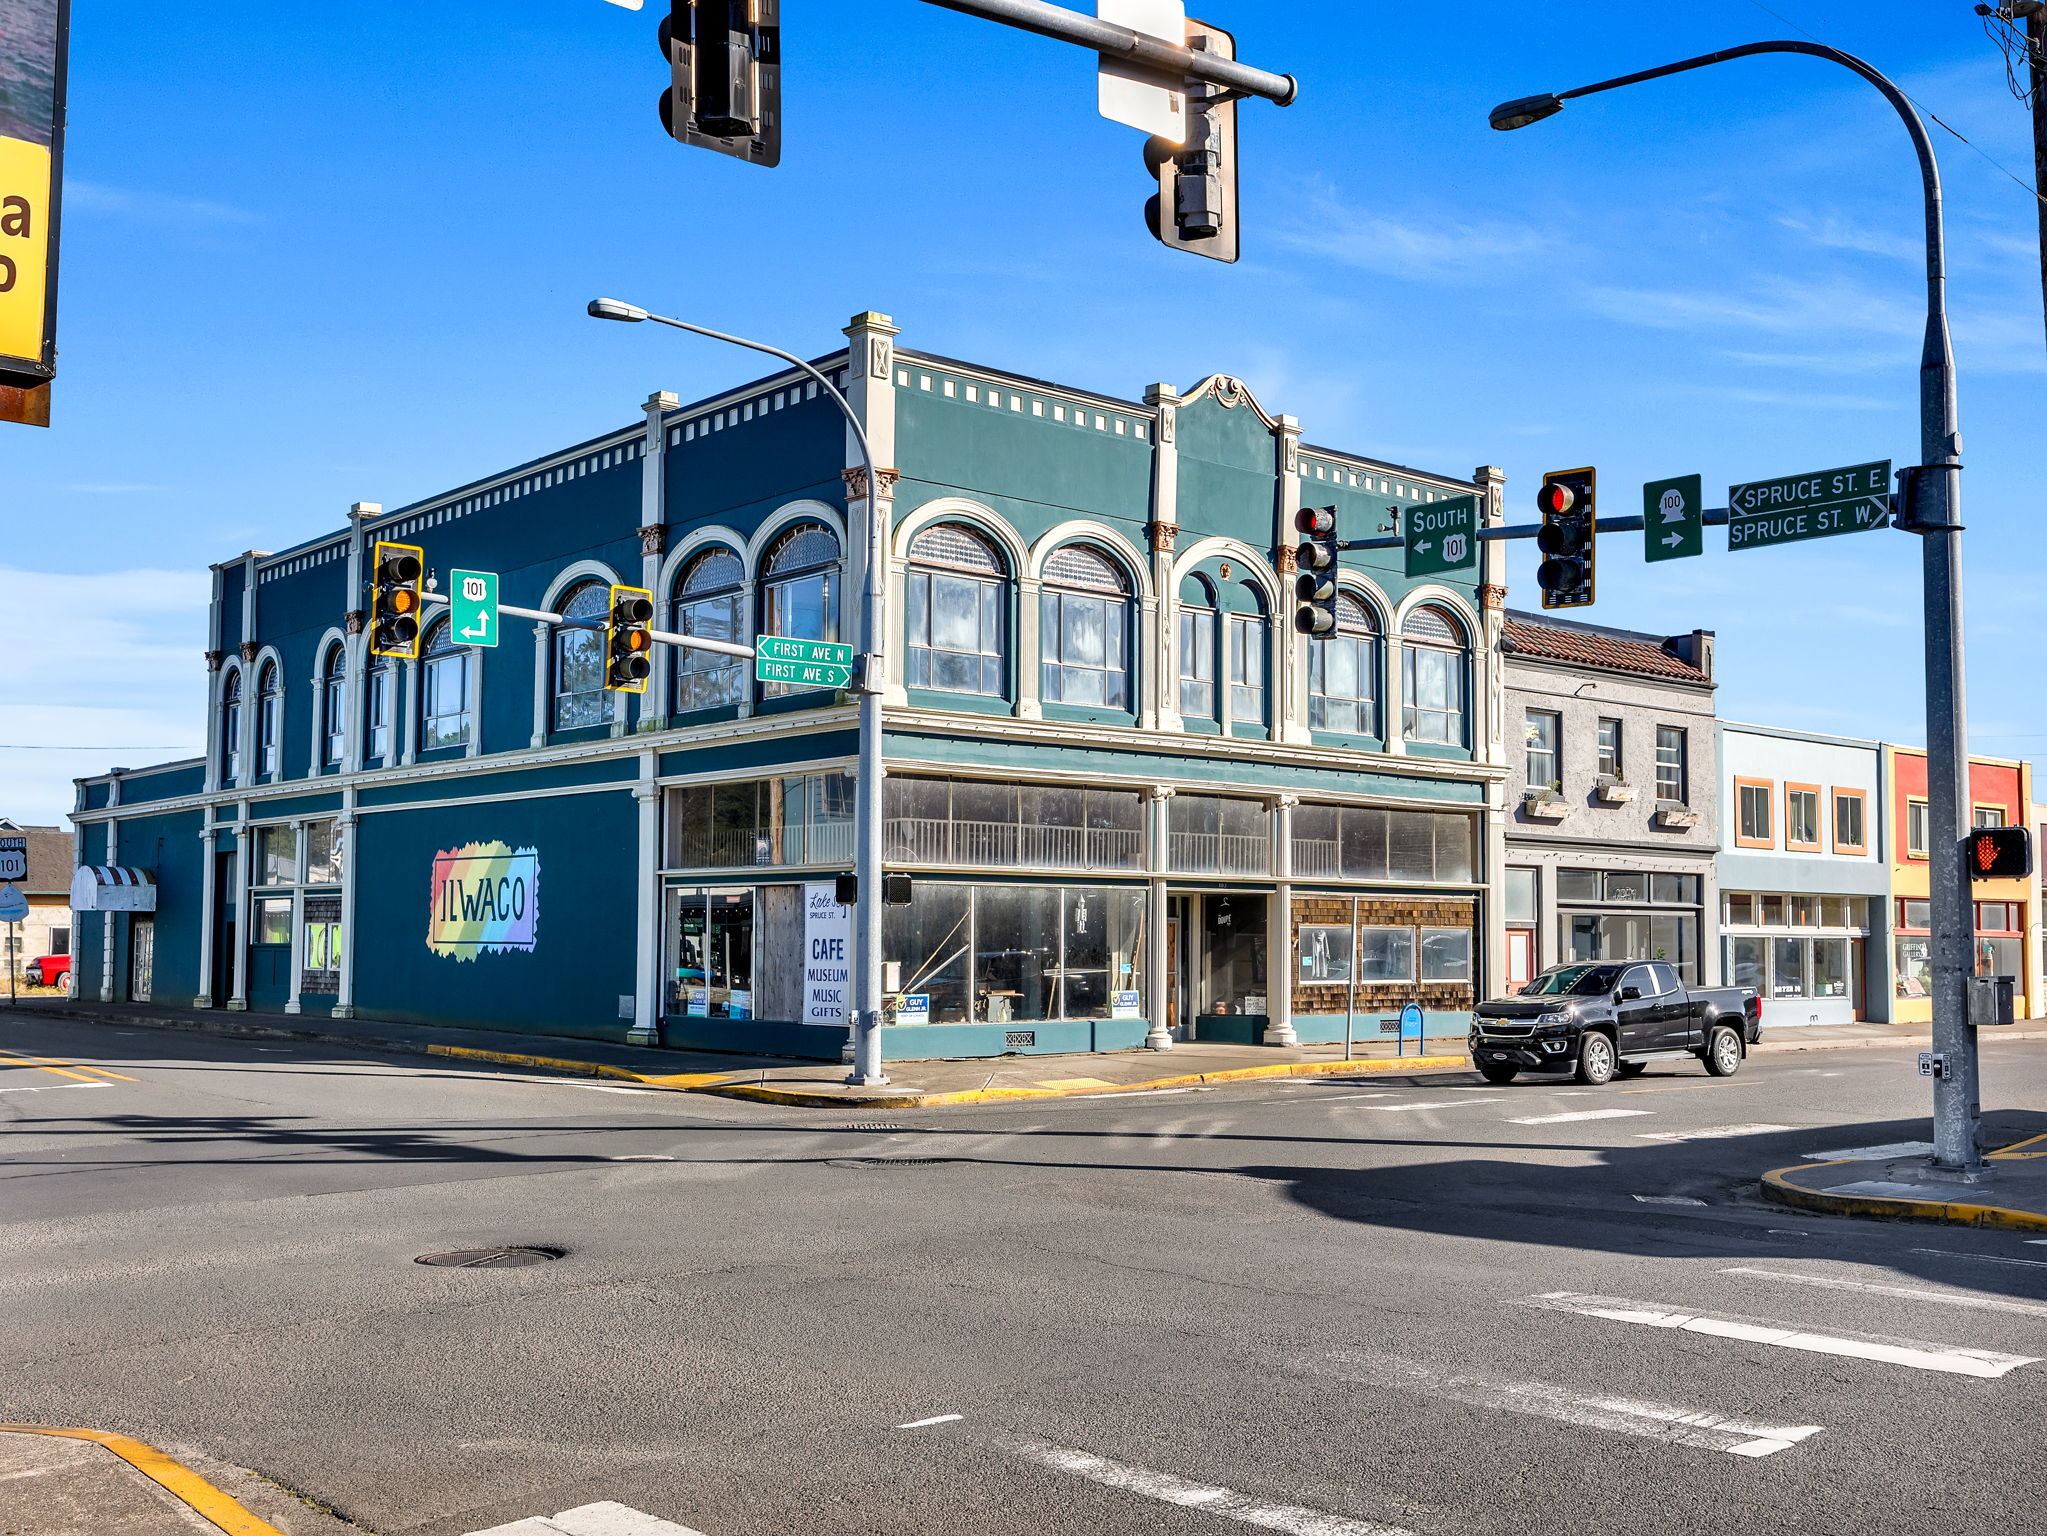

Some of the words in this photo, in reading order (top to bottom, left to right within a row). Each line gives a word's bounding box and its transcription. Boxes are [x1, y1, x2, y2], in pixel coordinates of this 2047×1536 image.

[1744, 479, 1822, 508] SPRUCE
[1832, 473, 1858, 494] ST.
[1869, 469, 1886, 488] E.
[1664, 495, 1680, 509] 100
[1413, 508, 1467, 533] SOUTH
[1731, 515, 1808, 543] SPRUCE
[1817, 510, 1844, 530] ST.
[1855, 505, 1873, 524] W.
[1446, 539, 1462, 557] 101
[467, 582, 482, 597] 101
[774, 642, 804, 657] FIRST
[812, 646, 831, 661] AVE
[837, 649, 844, 662] N
[765, 663, 795, 678] FIRST
[803, 667, 822, 681] AVE
[828, 670, 834, 683] S
[0, 838, 23, 848] OUTH
[1, 859, 19, 872] 101
[440, 876, 525, 922] ILWACO
[809, 892, 831, 909] Lake
[809, 911, 827, 919] SPRUCE
[828, 911, 836, 919] ST.
[812, 938, 844, 961] CAFE
[807, 968, 848, 982] MUSEUM
[812, 988, 842, 1003] MUSIC
[909, 998, 924, 1006] GUY
[811, 1006, 842, 1017] GIFTS
